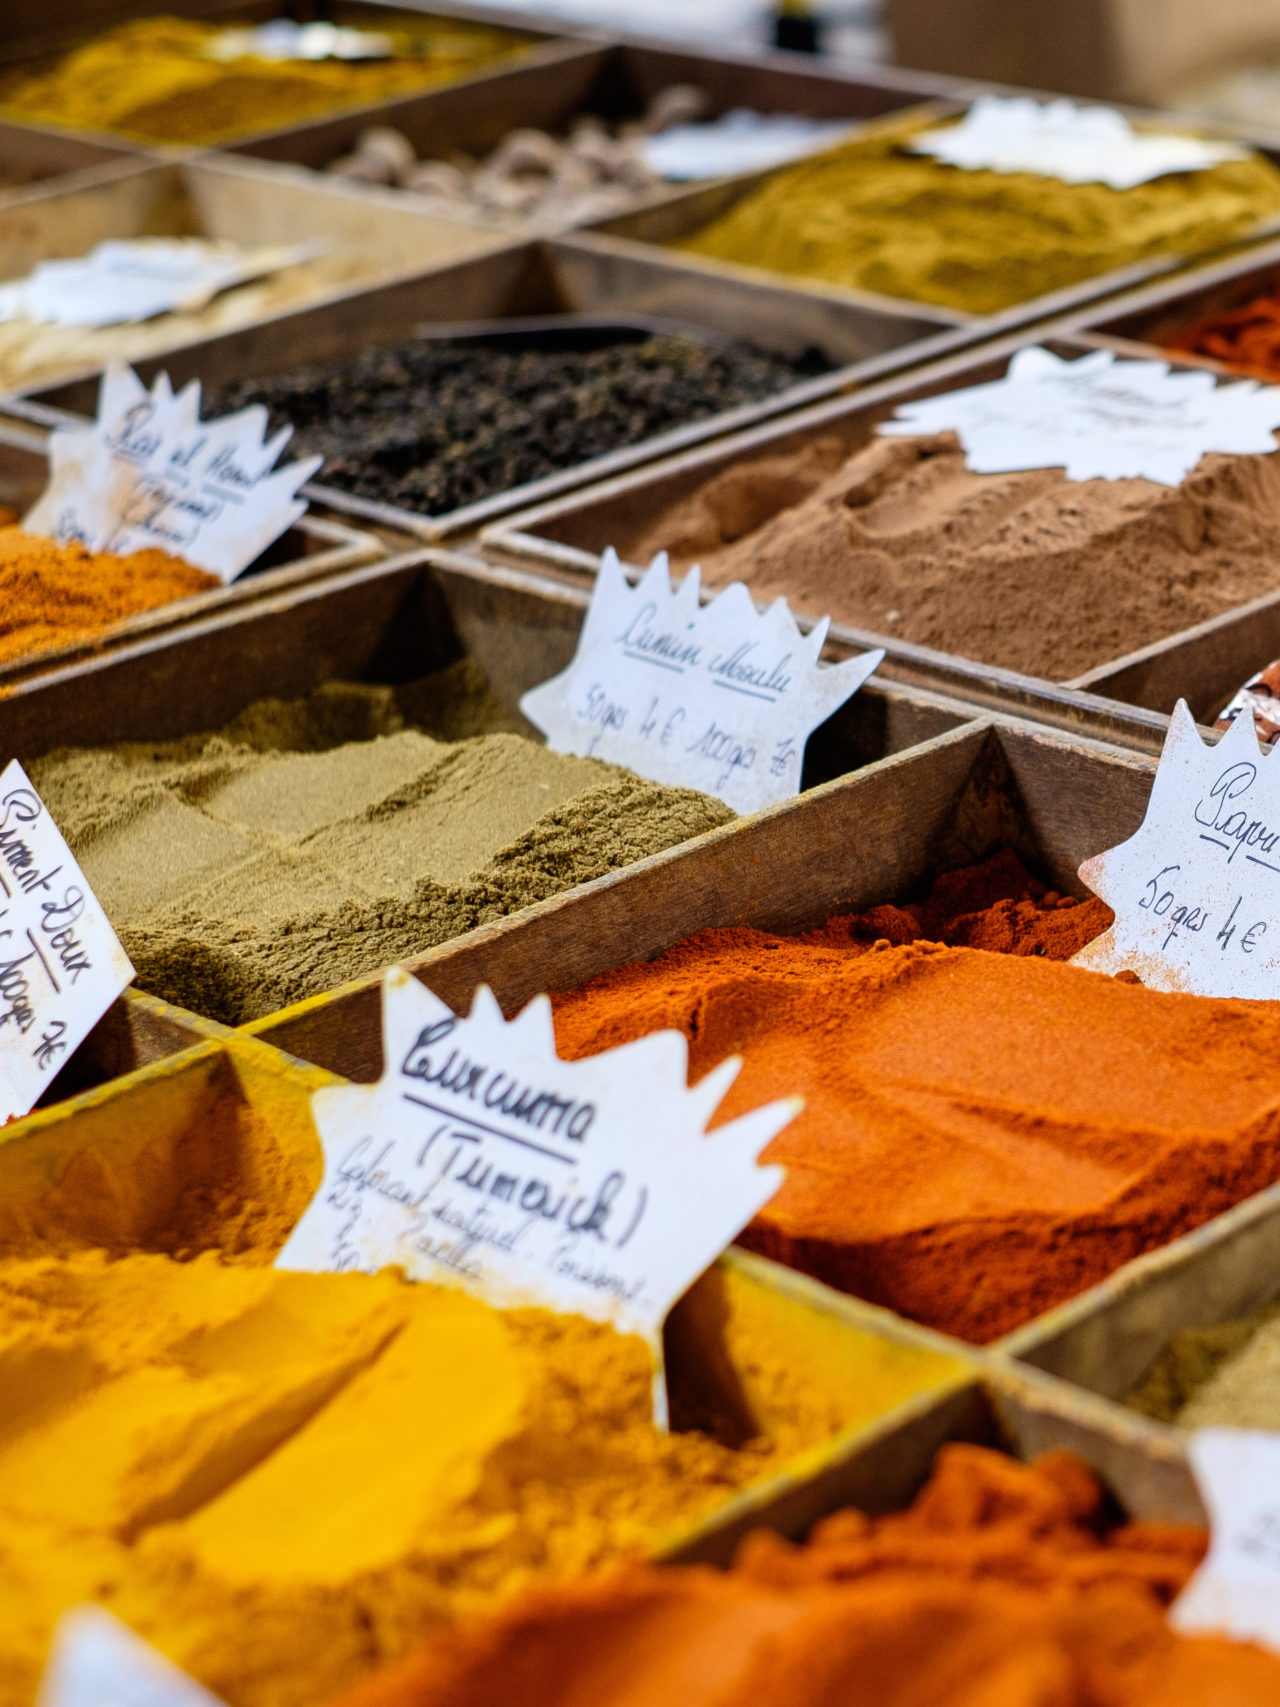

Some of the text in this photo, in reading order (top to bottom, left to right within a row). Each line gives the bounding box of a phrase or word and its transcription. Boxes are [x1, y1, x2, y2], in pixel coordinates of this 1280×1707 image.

[615, 601, 704, 667] Cumin
[41, 885, 94, 985] Doux
[402, 1017, 596, 1143] Curcuma
